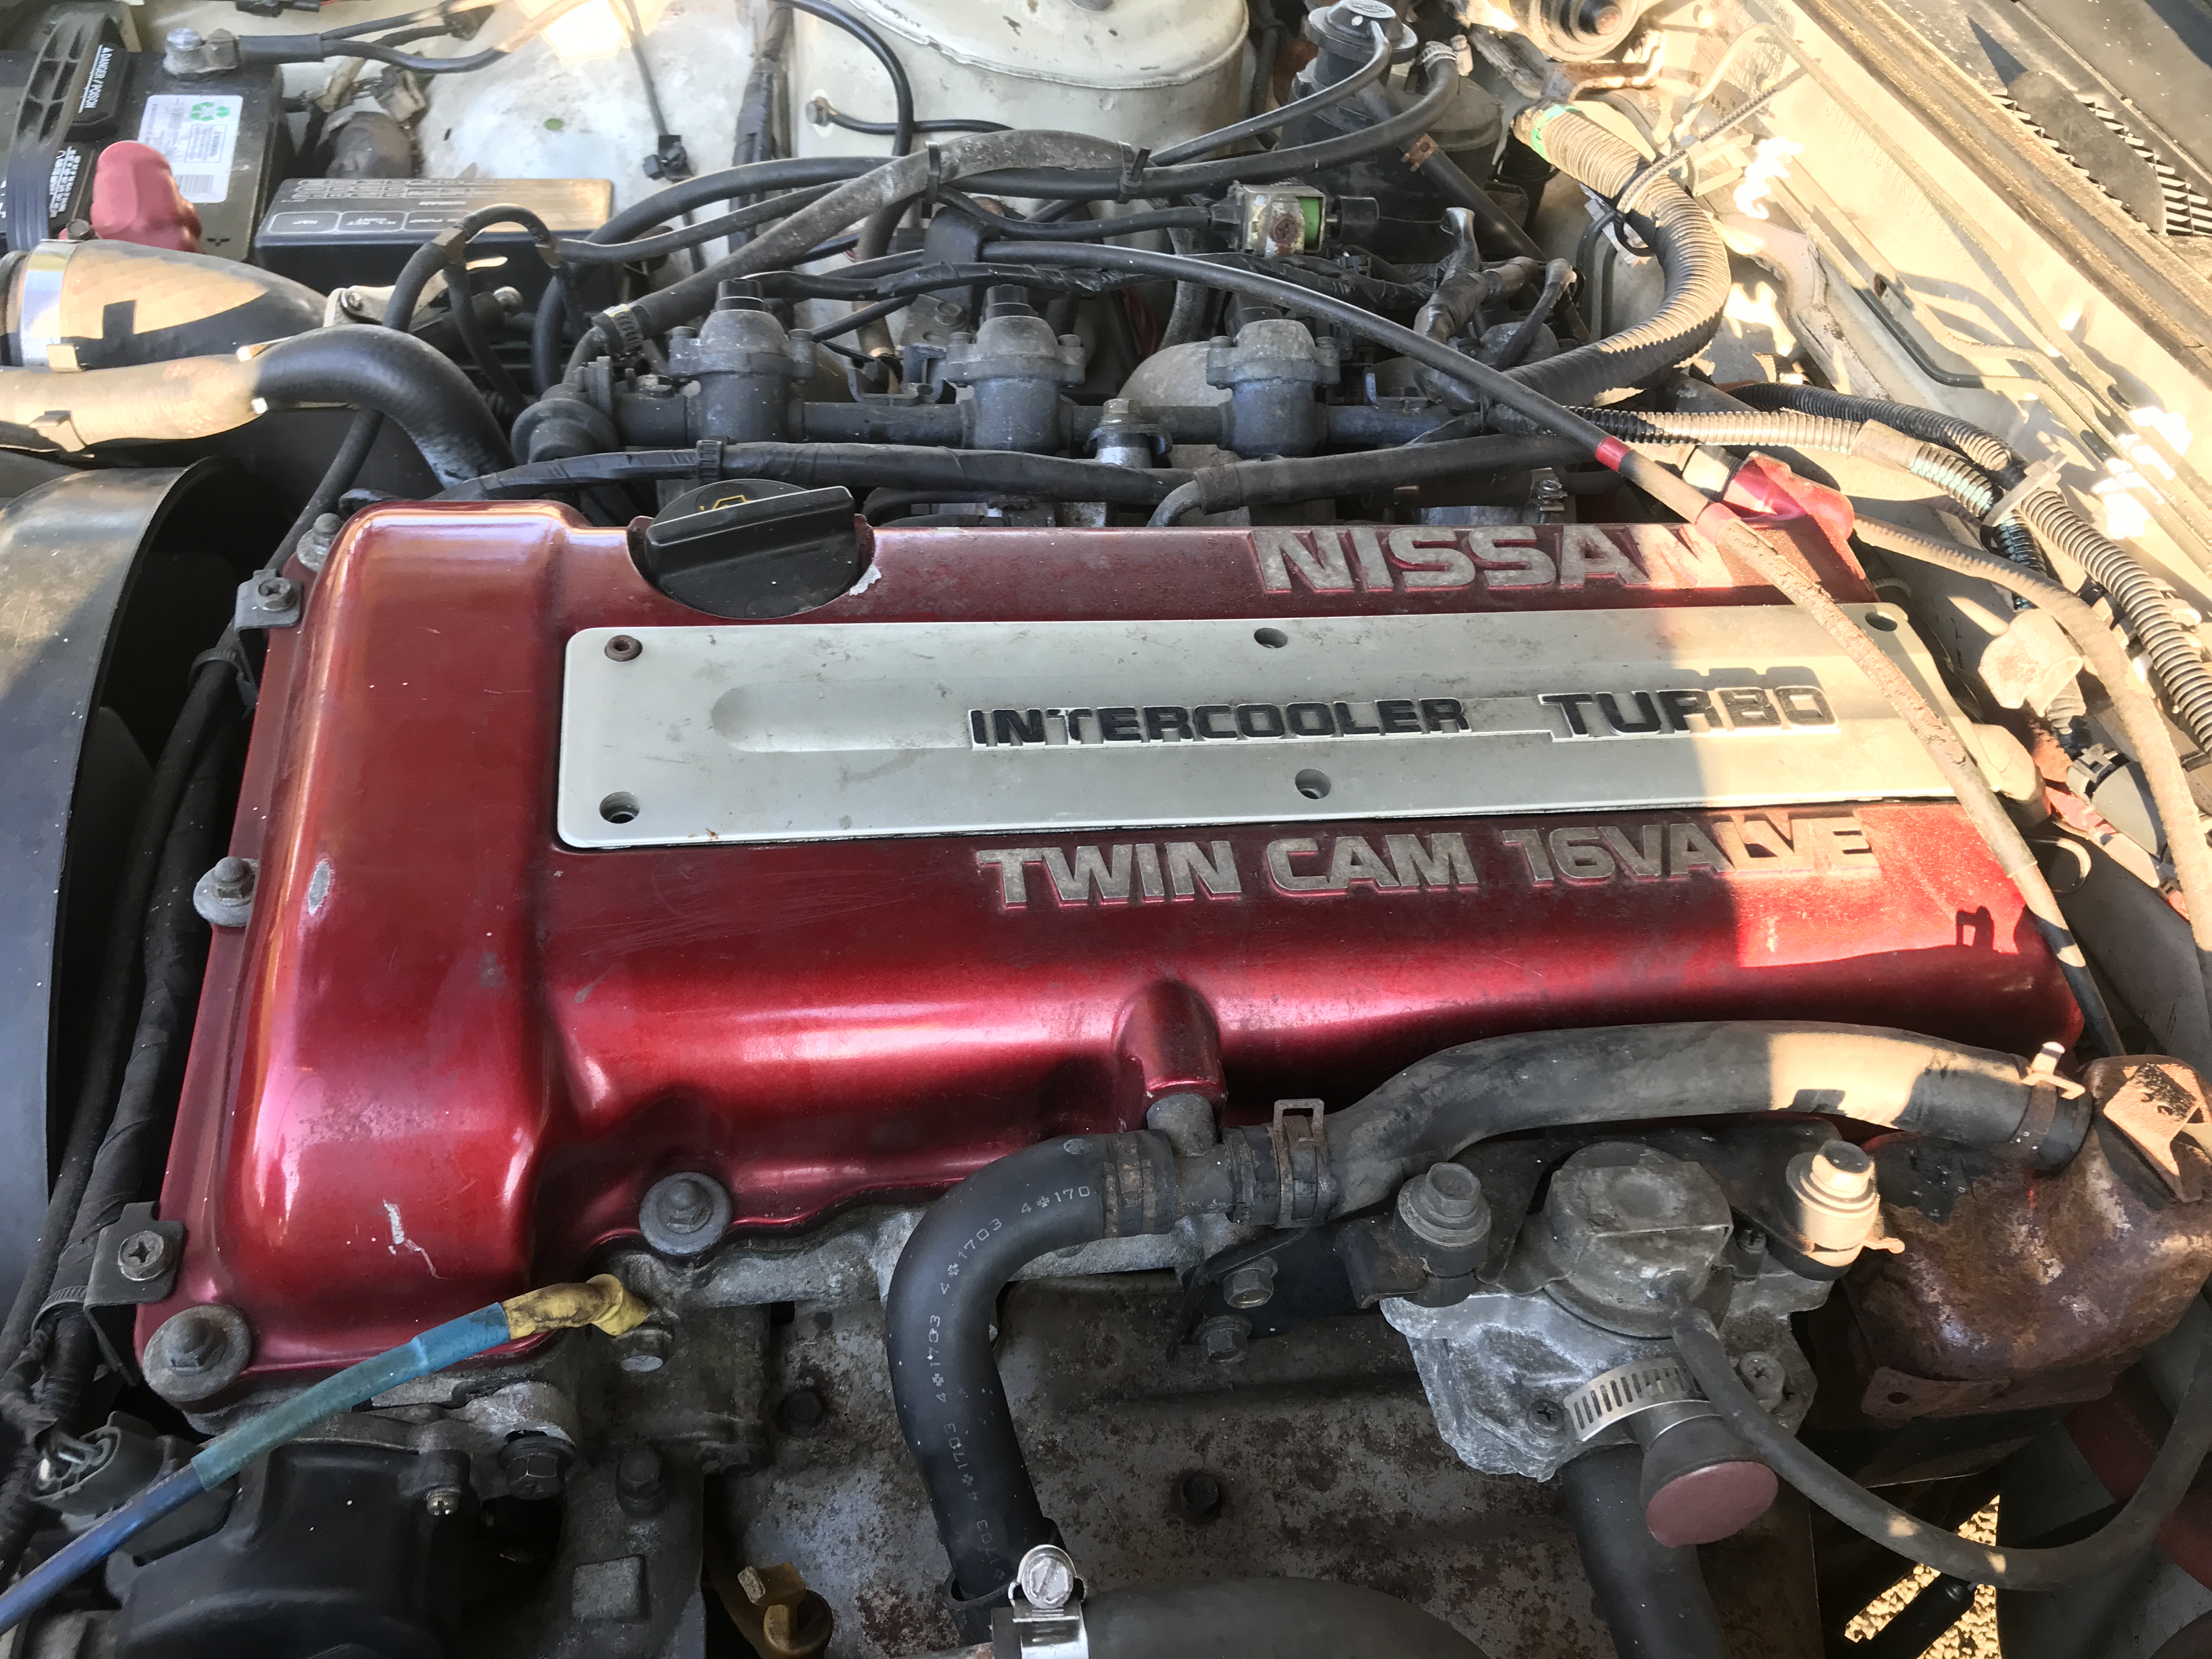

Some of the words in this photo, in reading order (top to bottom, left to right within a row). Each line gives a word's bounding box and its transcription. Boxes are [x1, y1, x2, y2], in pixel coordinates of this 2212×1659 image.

[93, 53, 113, 79] DANGER
[1249, 524, 1733, 591] NISSAN
[970, 698, 1471, 747] INTERCOOLER
[1539, 685, 1838, 740] TURBO
[978, 840, 1242, 907] TWIN
[1267, 832, 1478, 894] CAM
[1503, 816, 1880, 882] 16VALVE
